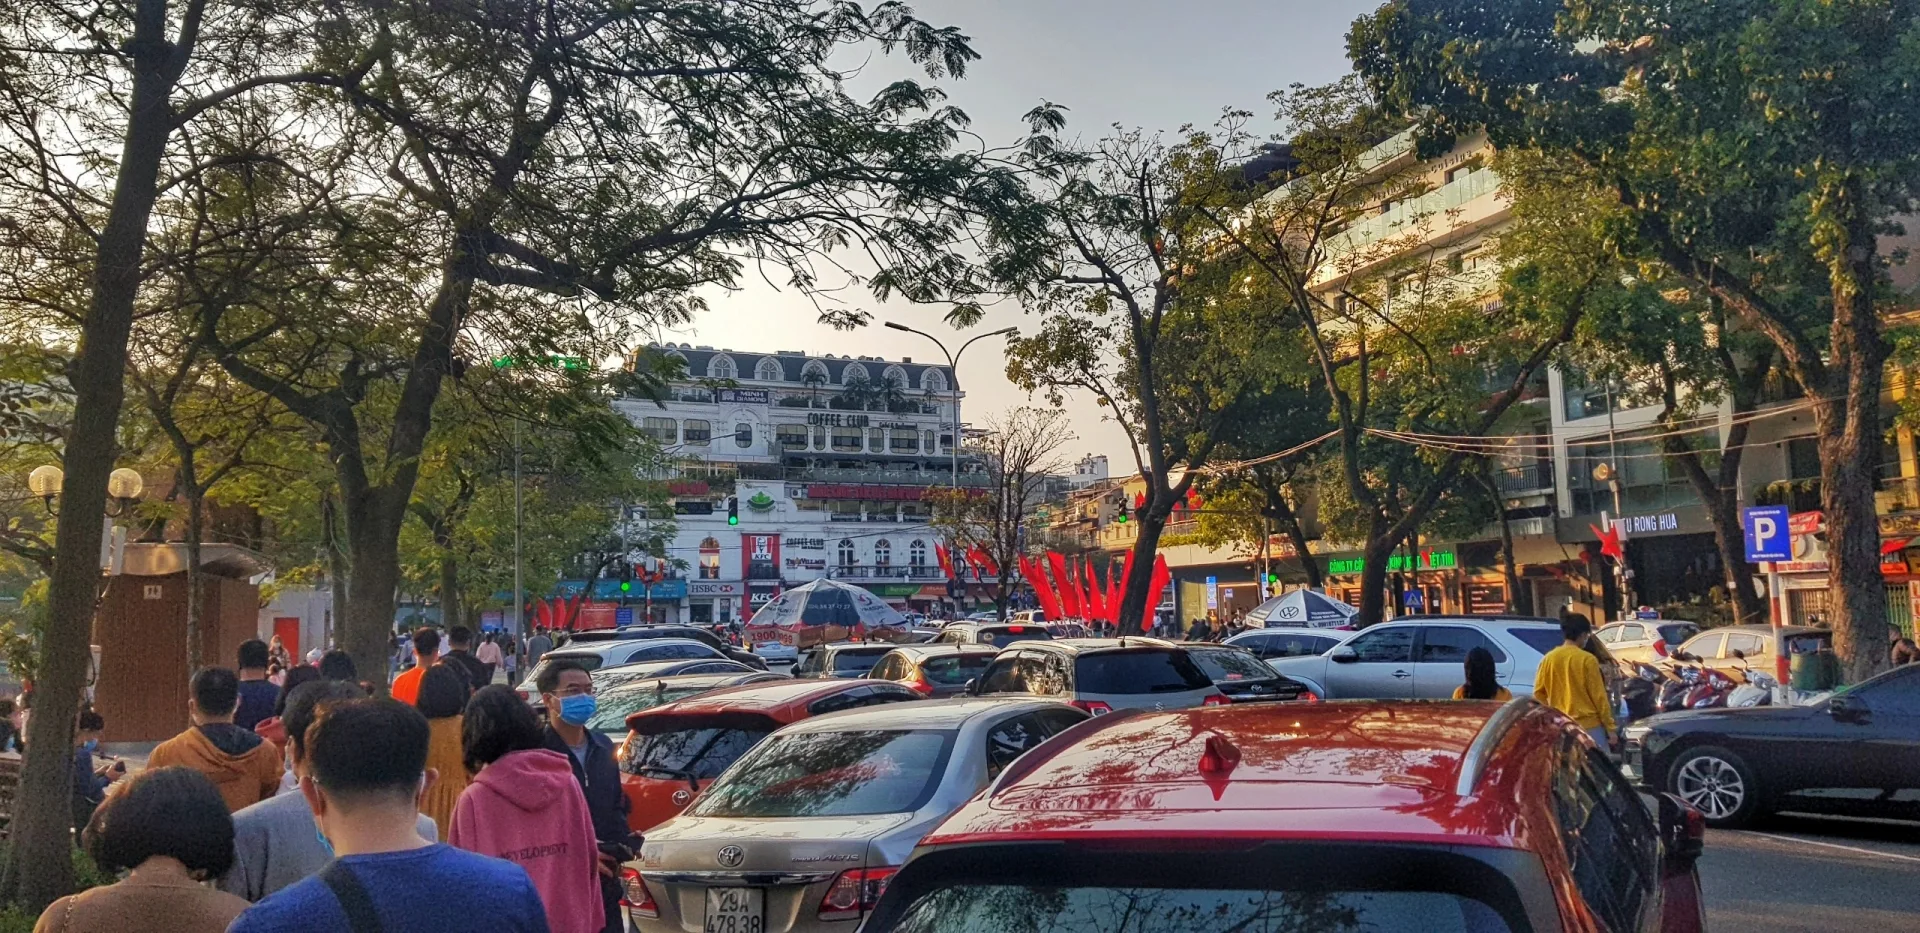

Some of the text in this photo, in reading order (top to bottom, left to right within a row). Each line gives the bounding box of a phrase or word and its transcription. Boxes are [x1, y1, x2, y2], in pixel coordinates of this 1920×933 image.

[808, 412, 869, 427] COFFEE CLUB
[1634, 516, 1656, 532] RONG
[1660, 513, 1677, 530] HUA
[1755, 518, 1776, 551] P
[1330, 559, 1345, 572] CÔNG
[1346, 560, 1354, 571] TY
[691, 585, 717, 593] HSBC
[751, 592, 773, 600] KFC
[751, 630, 775, 641] 1900
[719, 890, 749, 912] 29A
